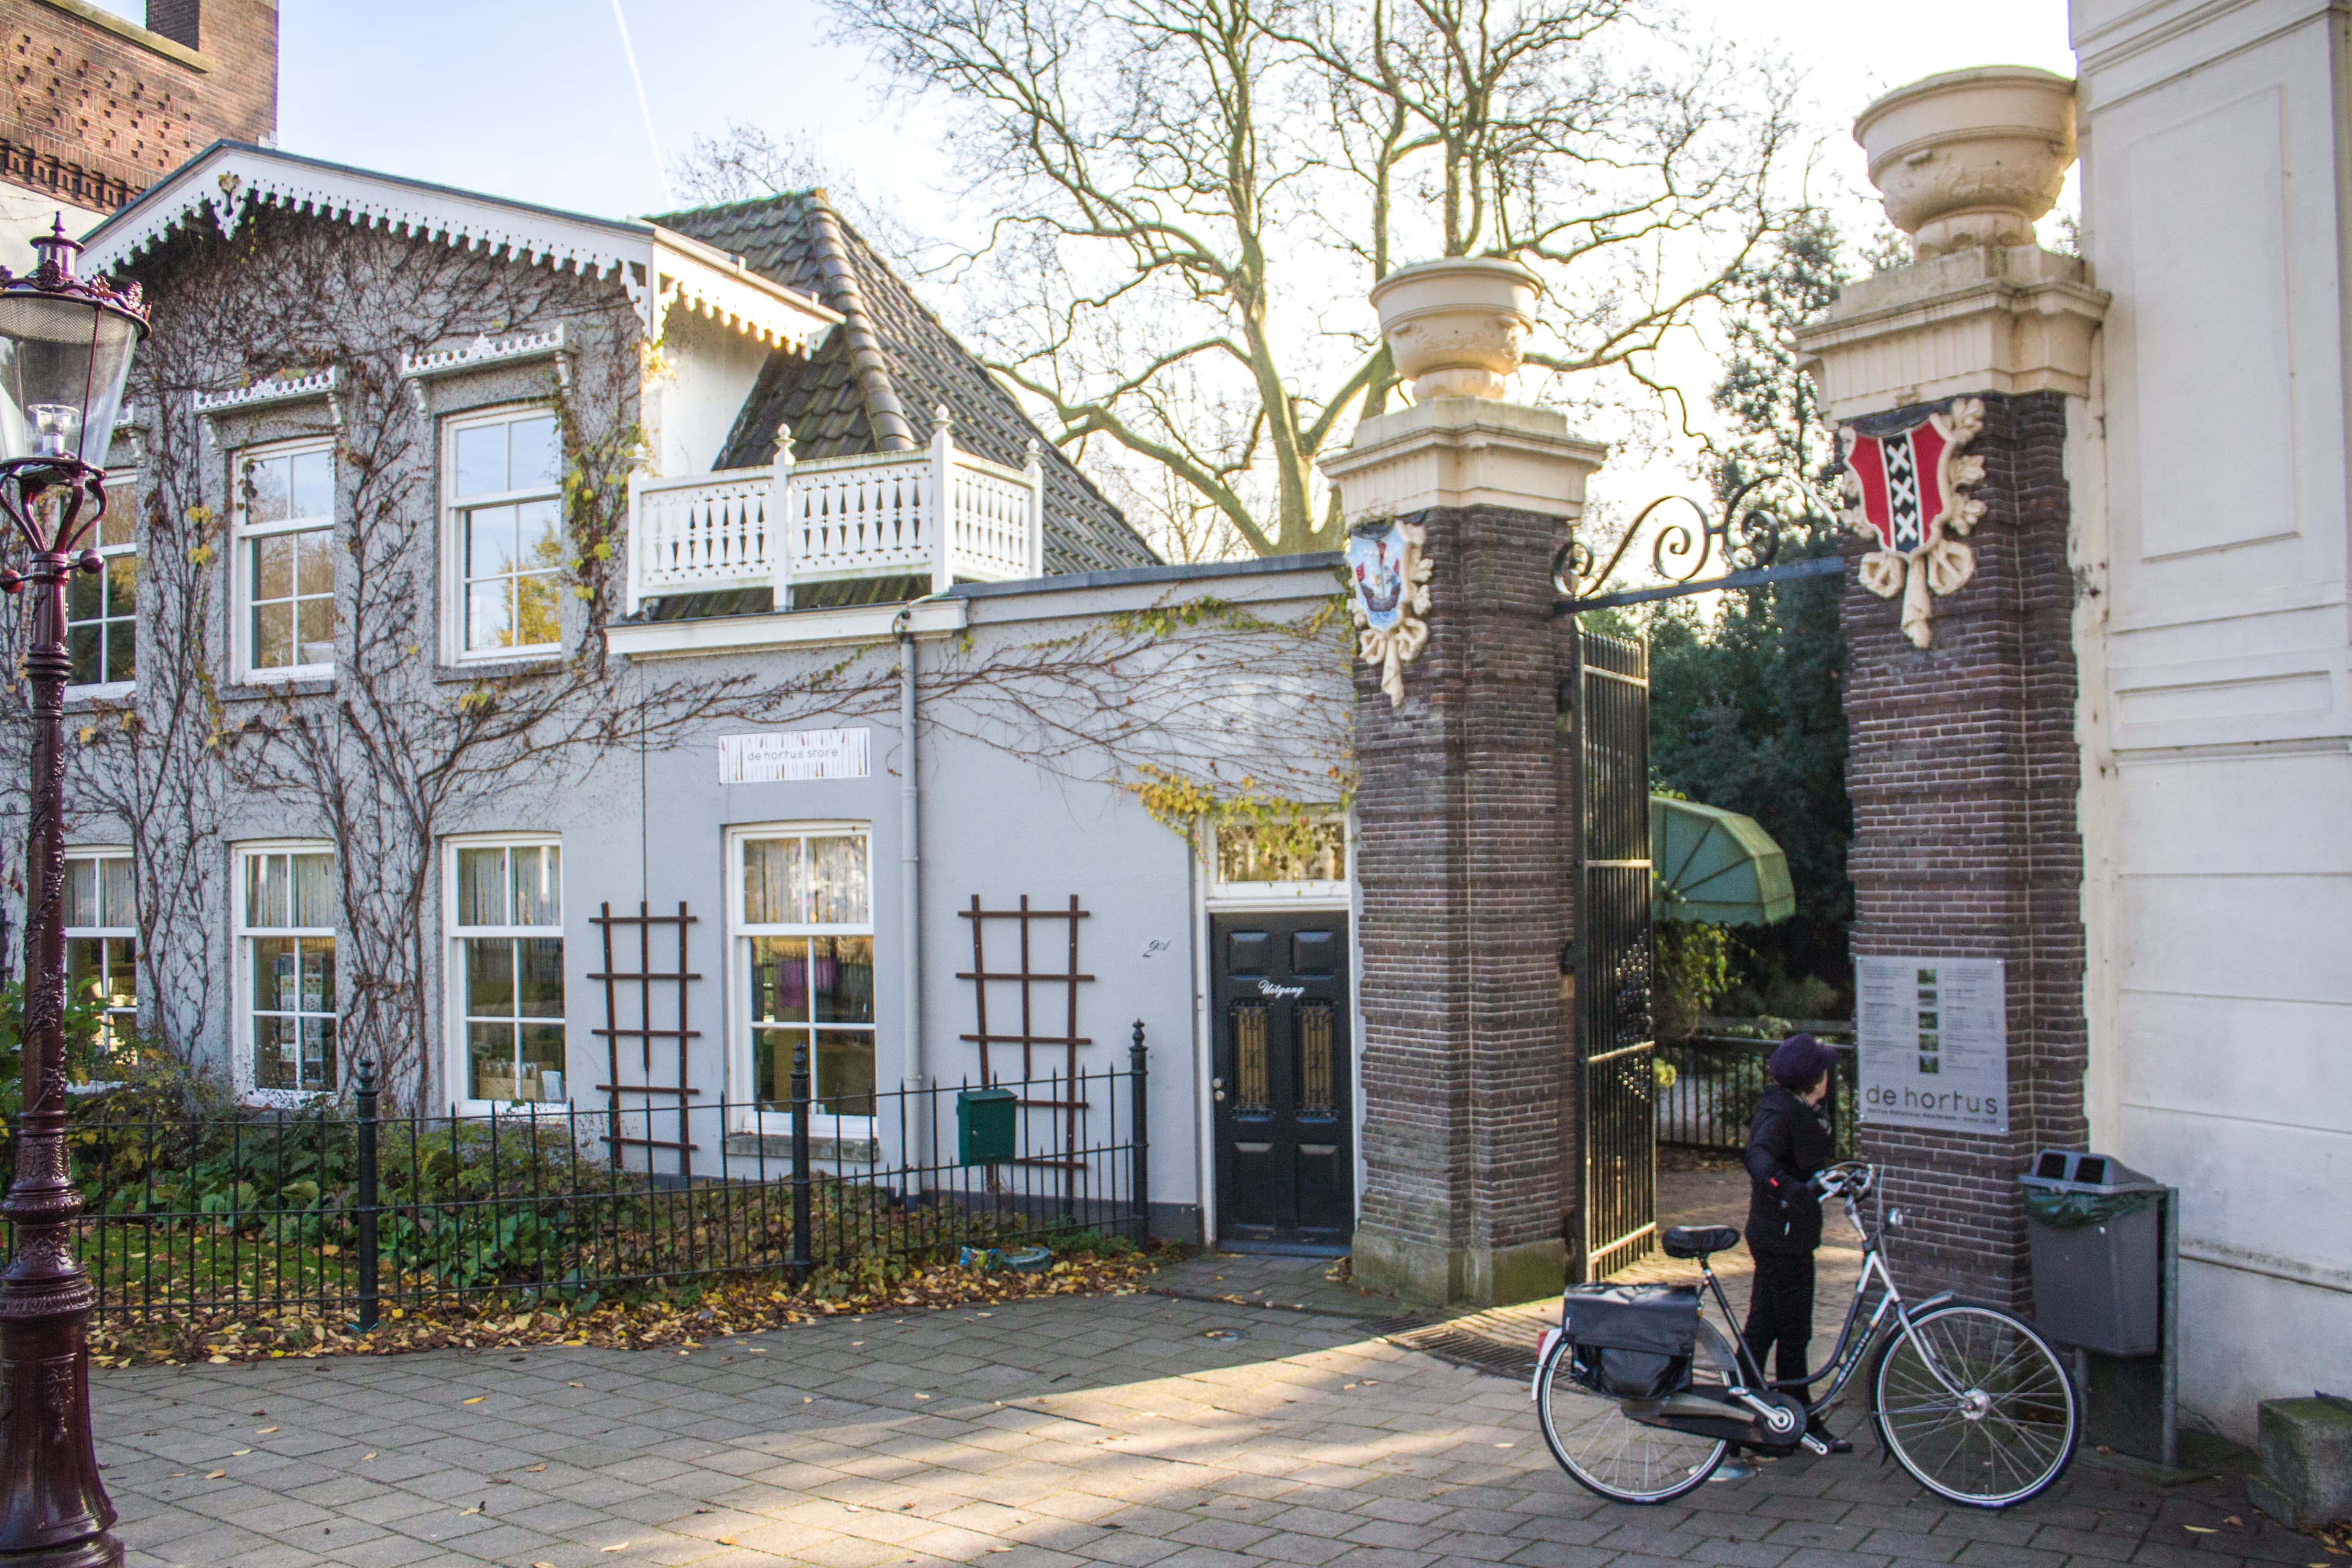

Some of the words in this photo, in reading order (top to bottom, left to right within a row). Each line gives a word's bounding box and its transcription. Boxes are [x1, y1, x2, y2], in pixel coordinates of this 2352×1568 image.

[747, 752, 761, 761] de
[766, 748, 804, 760] hortus
[808, 747, 839, 758] store
[1258, 979, 1305, 999] Uitgang
[1866, 1084, 1896, 1105] de
[1905, 1087, 1998, 1115] hortus
